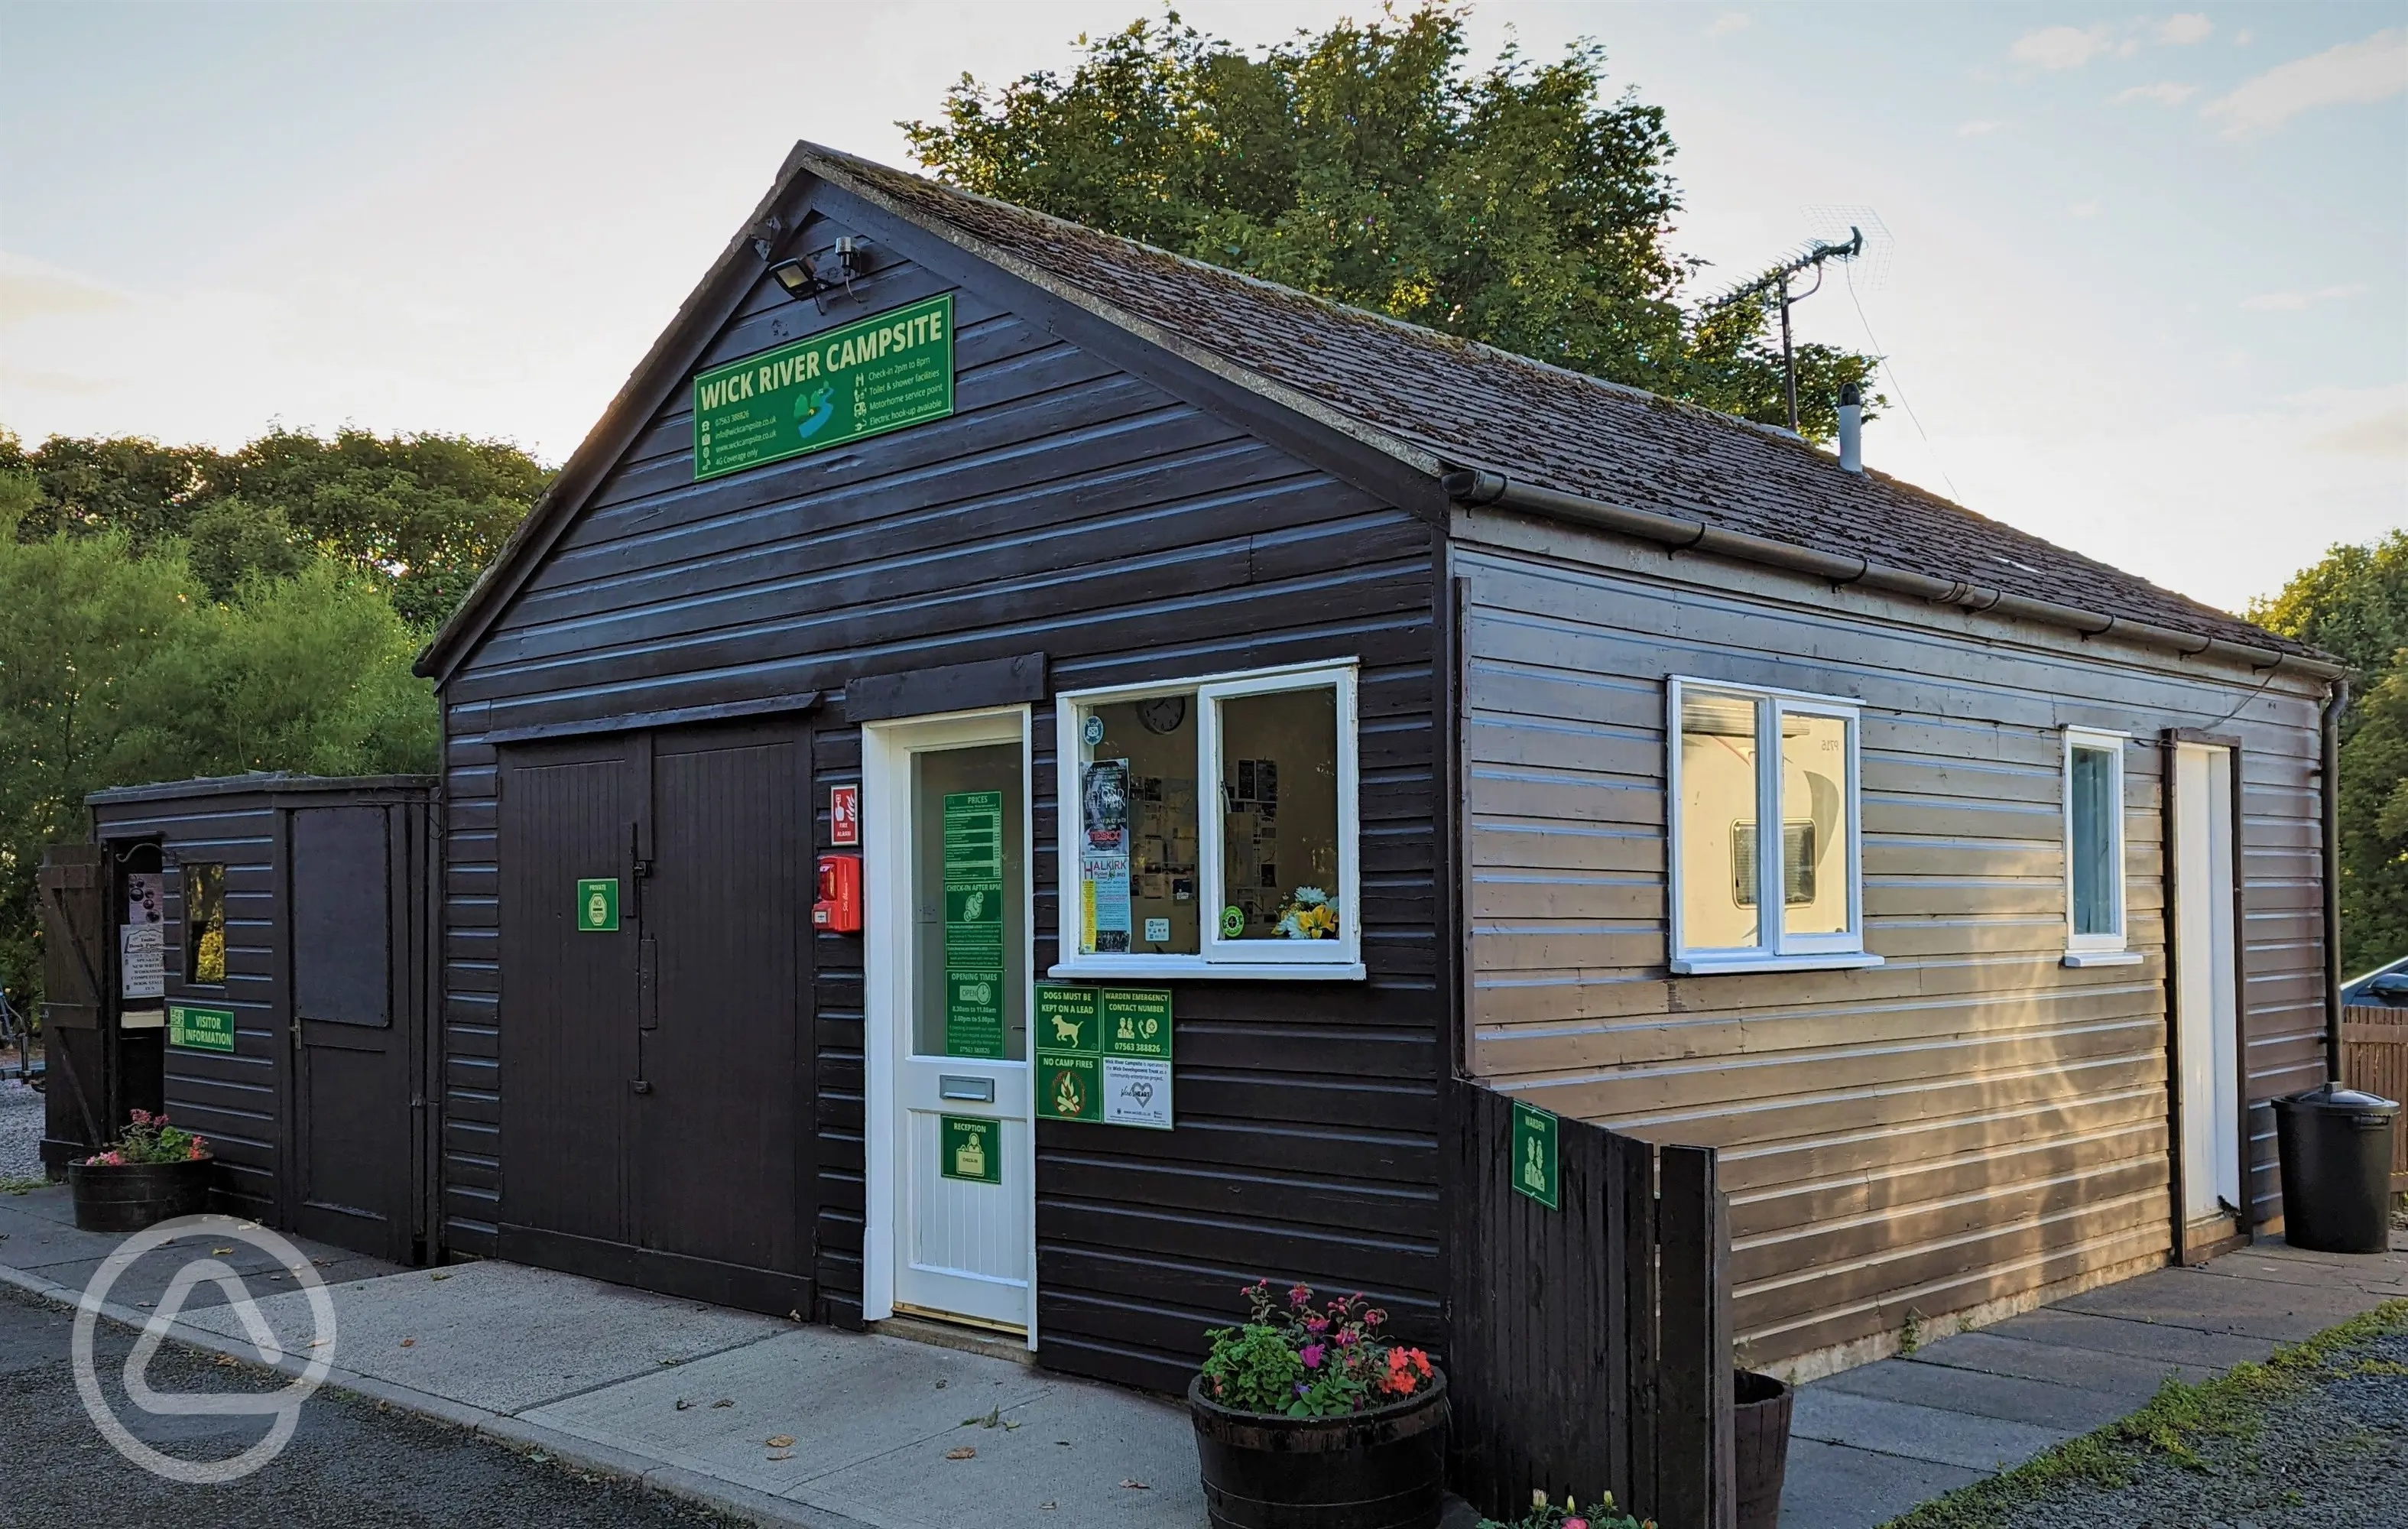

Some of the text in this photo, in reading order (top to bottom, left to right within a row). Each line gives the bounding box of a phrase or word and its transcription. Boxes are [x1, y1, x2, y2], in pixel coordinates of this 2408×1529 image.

[700, 310, 943, 411] WICK RIVER CAMPSITE
[868, 367, 893, 381] Check-in
[894, 363, 907, 374] 2pm
[917, 356, 930, 368] 8pm
[869, 369, 940, 395] Toilet & shower facilities
[870, 383, 943, 410] Motorhome service point
[870, 414, 891, 425] Electric
[891, 407, 916, 420] hook-up
[747, 446, 758, 458] only
[967, 795, 988, 804] PRICES
[1084, 859, 1127, 879] HALKIRK
[1043, 992, 1062, 1000] DOGS
[1063, 992, 1082, 1001] MUST
[1132, 993, 1168, 1001] EMERGENCY
[1041, 1004, 1057, 1012] KEPT
[1058, 1005, 1069, 1013] ON
[1137, 1005, 1164, 1013] NUMBER
[195, 1014, 221, 1030] VISITOR
[185, 1028, 232, 1045] INFORMATION
[1115, 1042, 1160, 1053] 07563 388826
[1043, 1057, 1093, 1069] NO CAMP FIRES
[953, 1122, 986, 1133] RECEPTION
[1525, 1114, 1545, 1132] WARDEN
